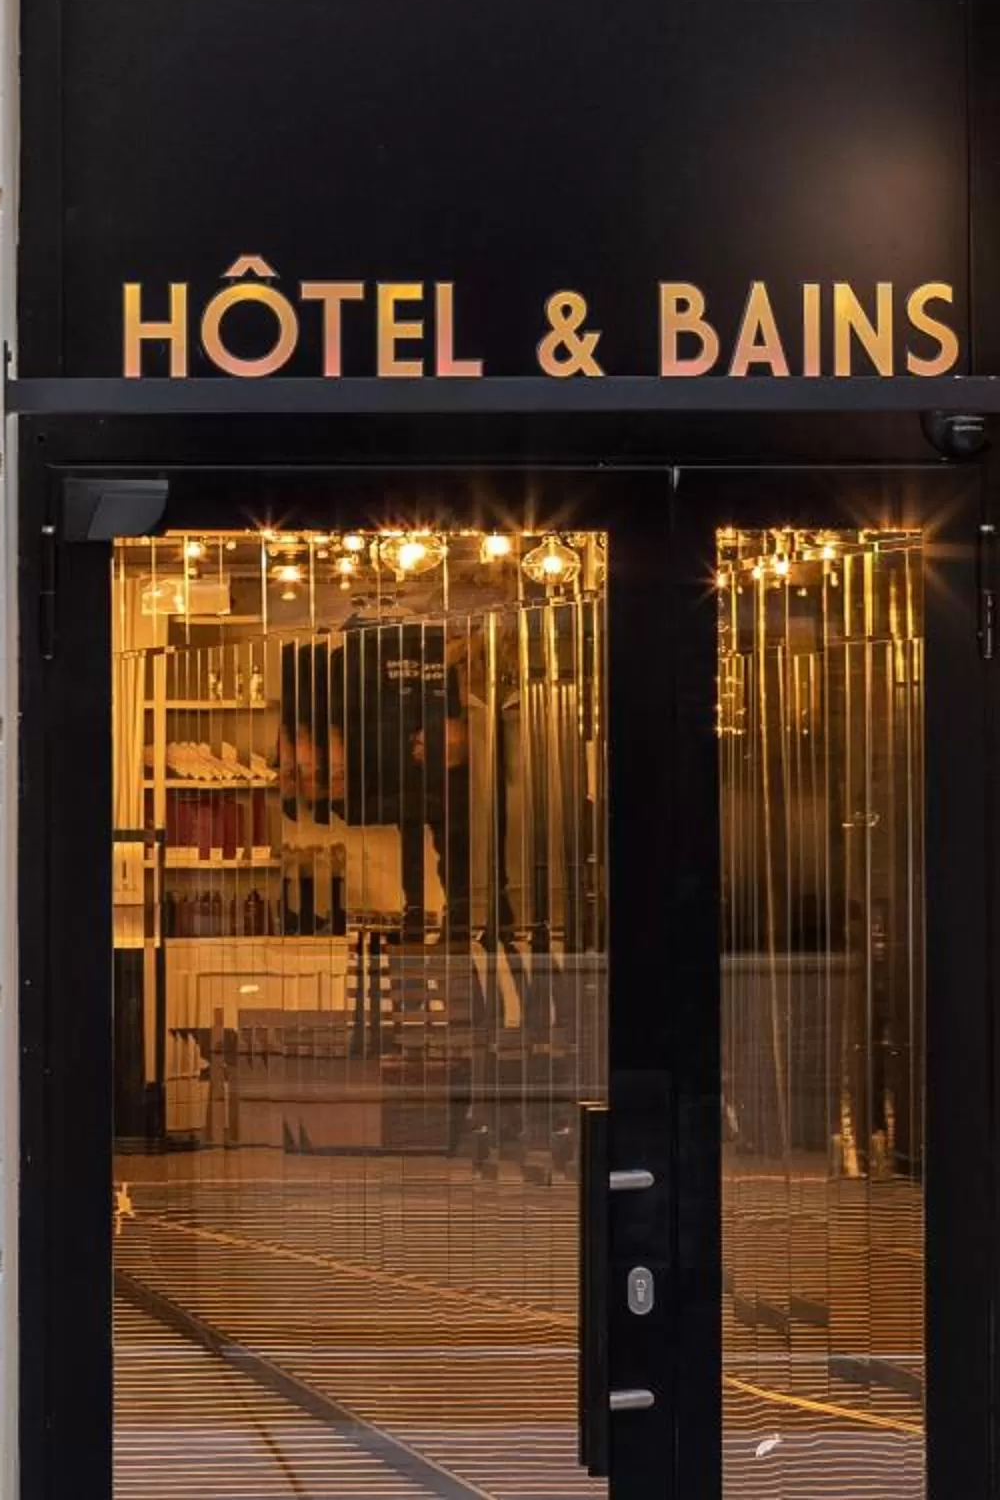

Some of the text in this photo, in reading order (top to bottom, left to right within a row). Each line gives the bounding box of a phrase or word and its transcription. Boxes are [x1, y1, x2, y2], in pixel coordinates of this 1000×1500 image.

[124, 255, 959, 377] HÔTEL & BAINS
